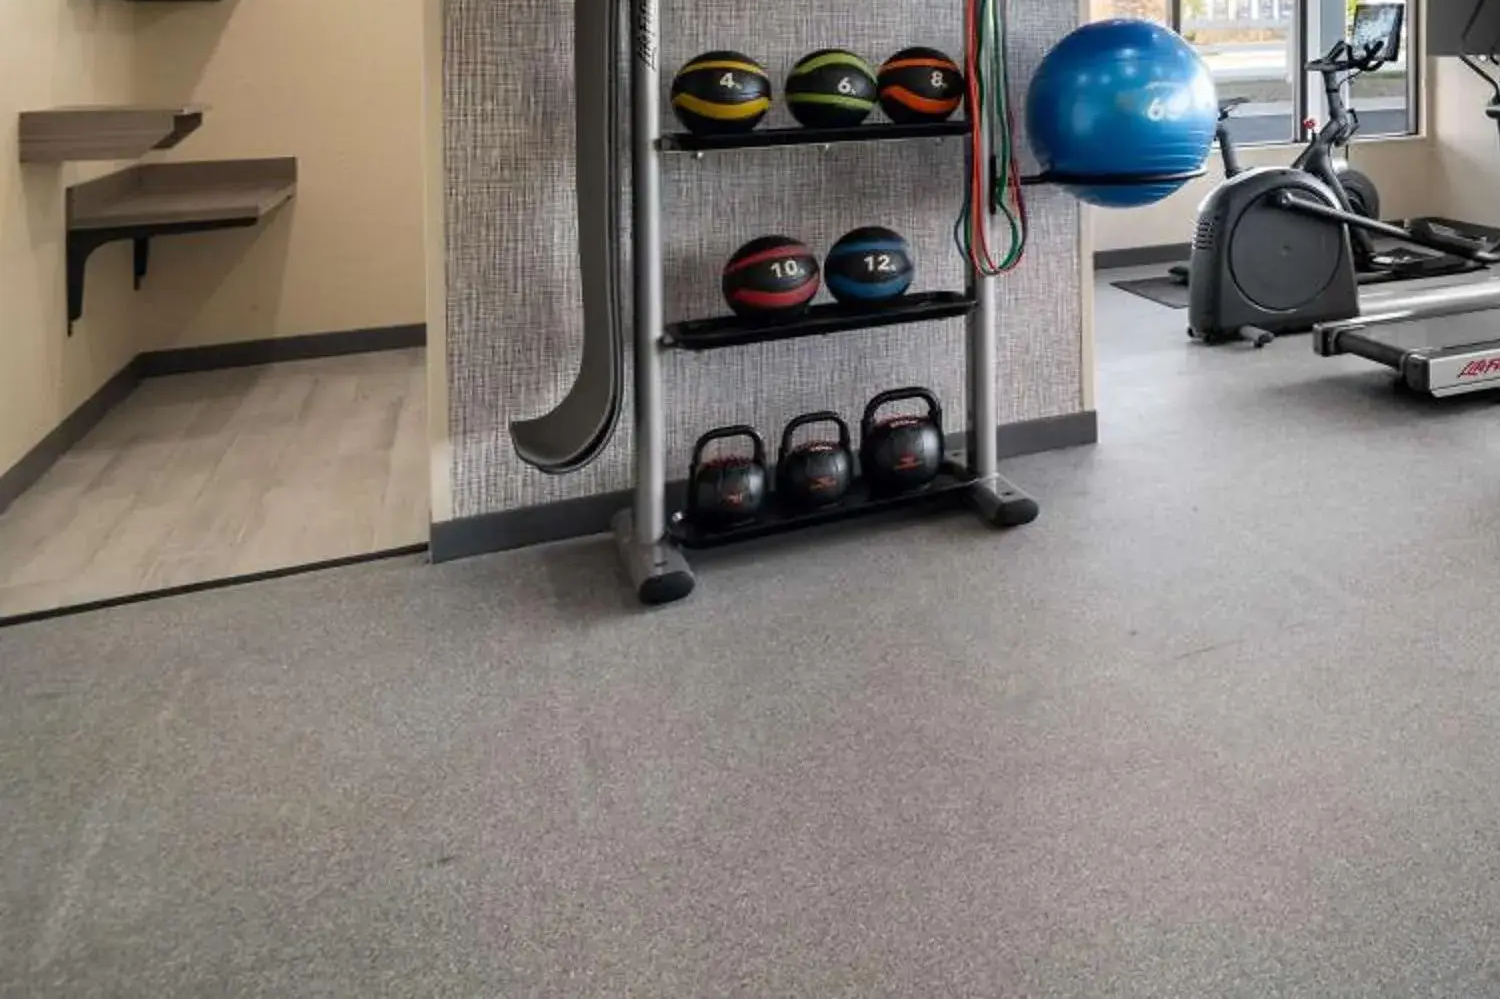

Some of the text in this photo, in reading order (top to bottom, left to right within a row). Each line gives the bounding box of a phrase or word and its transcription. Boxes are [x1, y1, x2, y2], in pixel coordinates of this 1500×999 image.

[719, 72, 735, 89] 4
[837, 77, 852, 94] 6
[930, 70, 944, 87] 8
[771, 258, 798, 279] 10
[863, 254, 890, 272] 12
